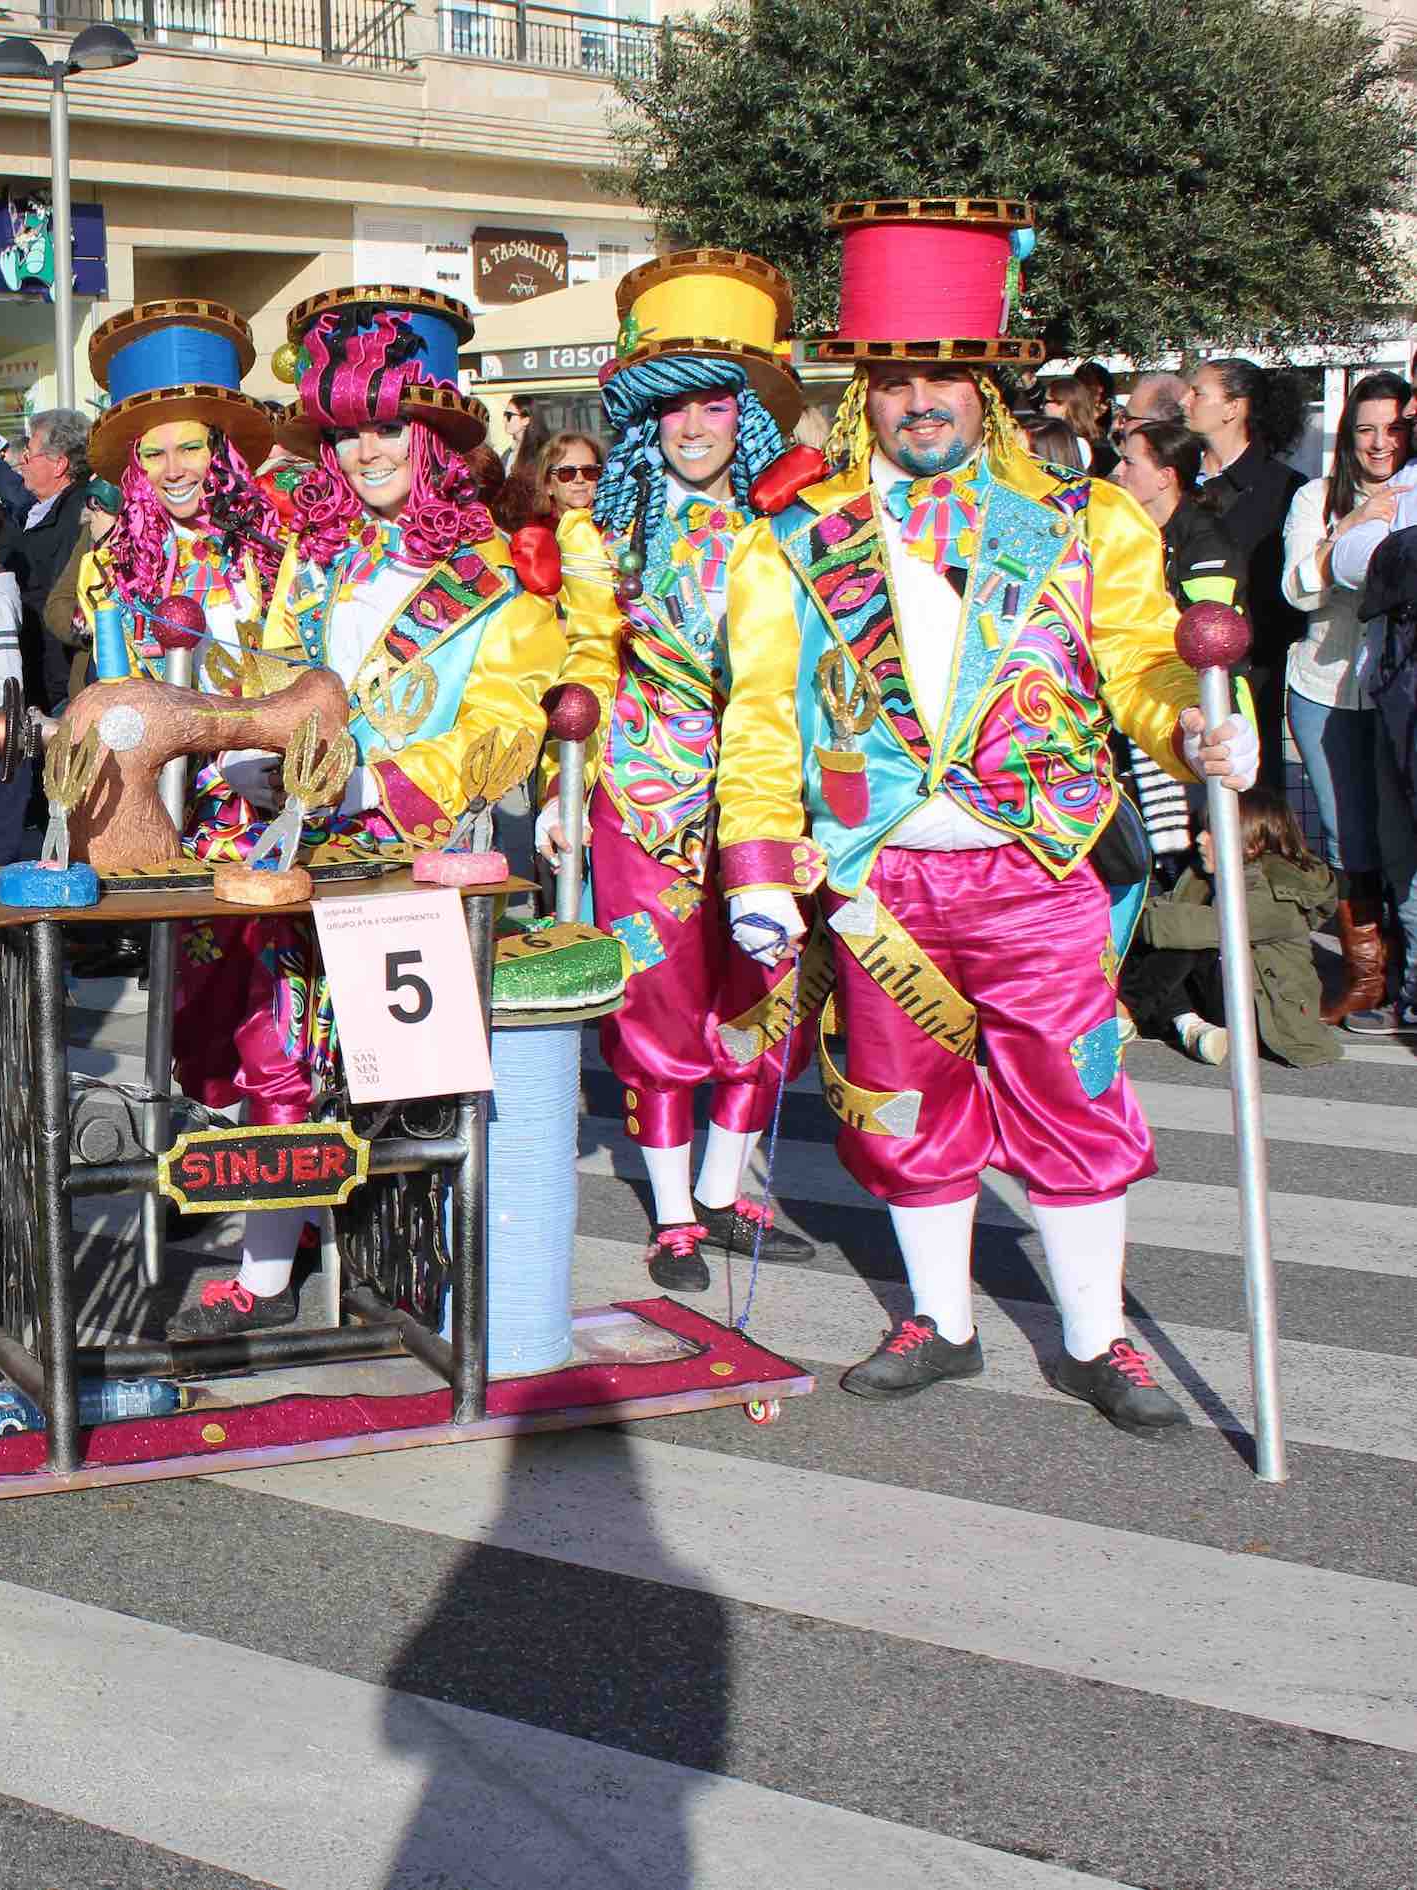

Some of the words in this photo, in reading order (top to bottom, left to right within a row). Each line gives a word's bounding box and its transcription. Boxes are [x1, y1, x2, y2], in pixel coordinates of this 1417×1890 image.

[480, 256, 492, 275] A
[523, 352, 538, 369] a
[385, 949, 433, 1024] 5
[182, 1144, 348, 1192] SINJER
